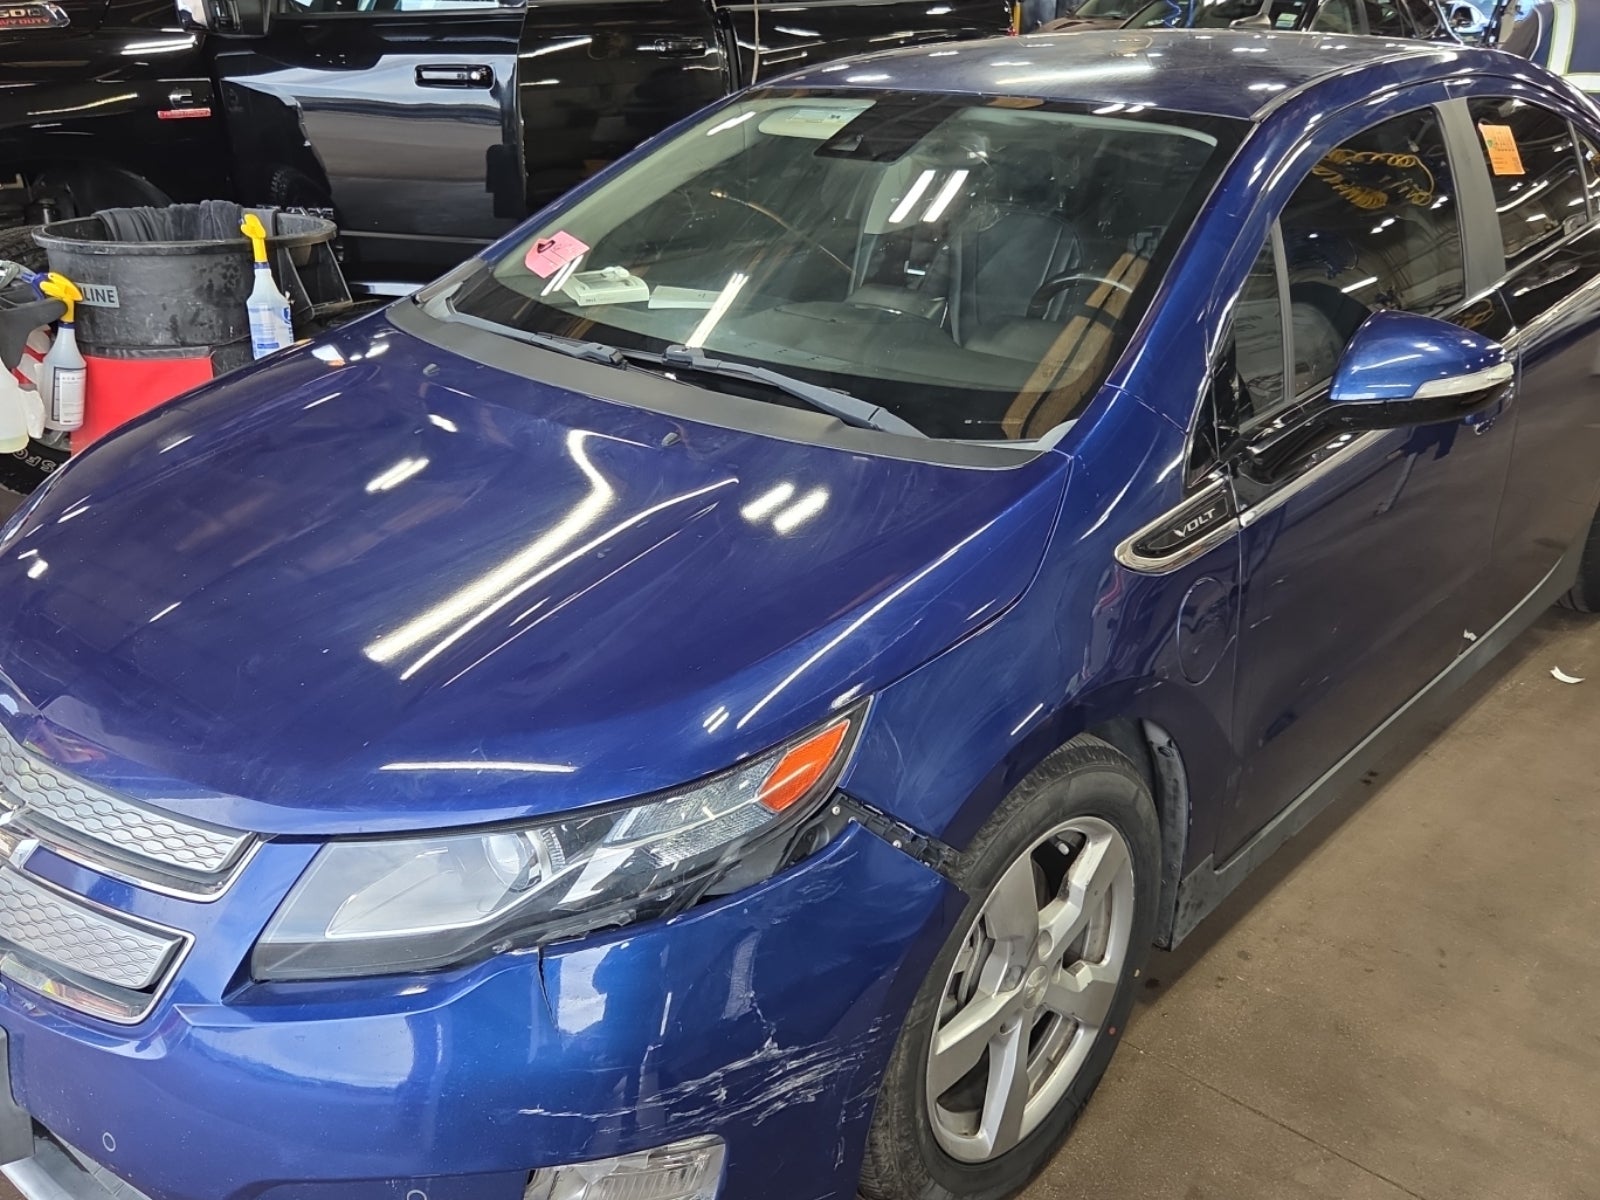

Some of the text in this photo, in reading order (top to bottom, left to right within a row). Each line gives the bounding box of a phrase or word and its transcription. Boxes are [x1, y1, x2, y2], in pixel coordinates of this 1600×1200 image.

[19, 17, 50, 25] DUTY
[82, 286, 116, 303] LINE
[1173, 507, 1216, 538] VOLT
